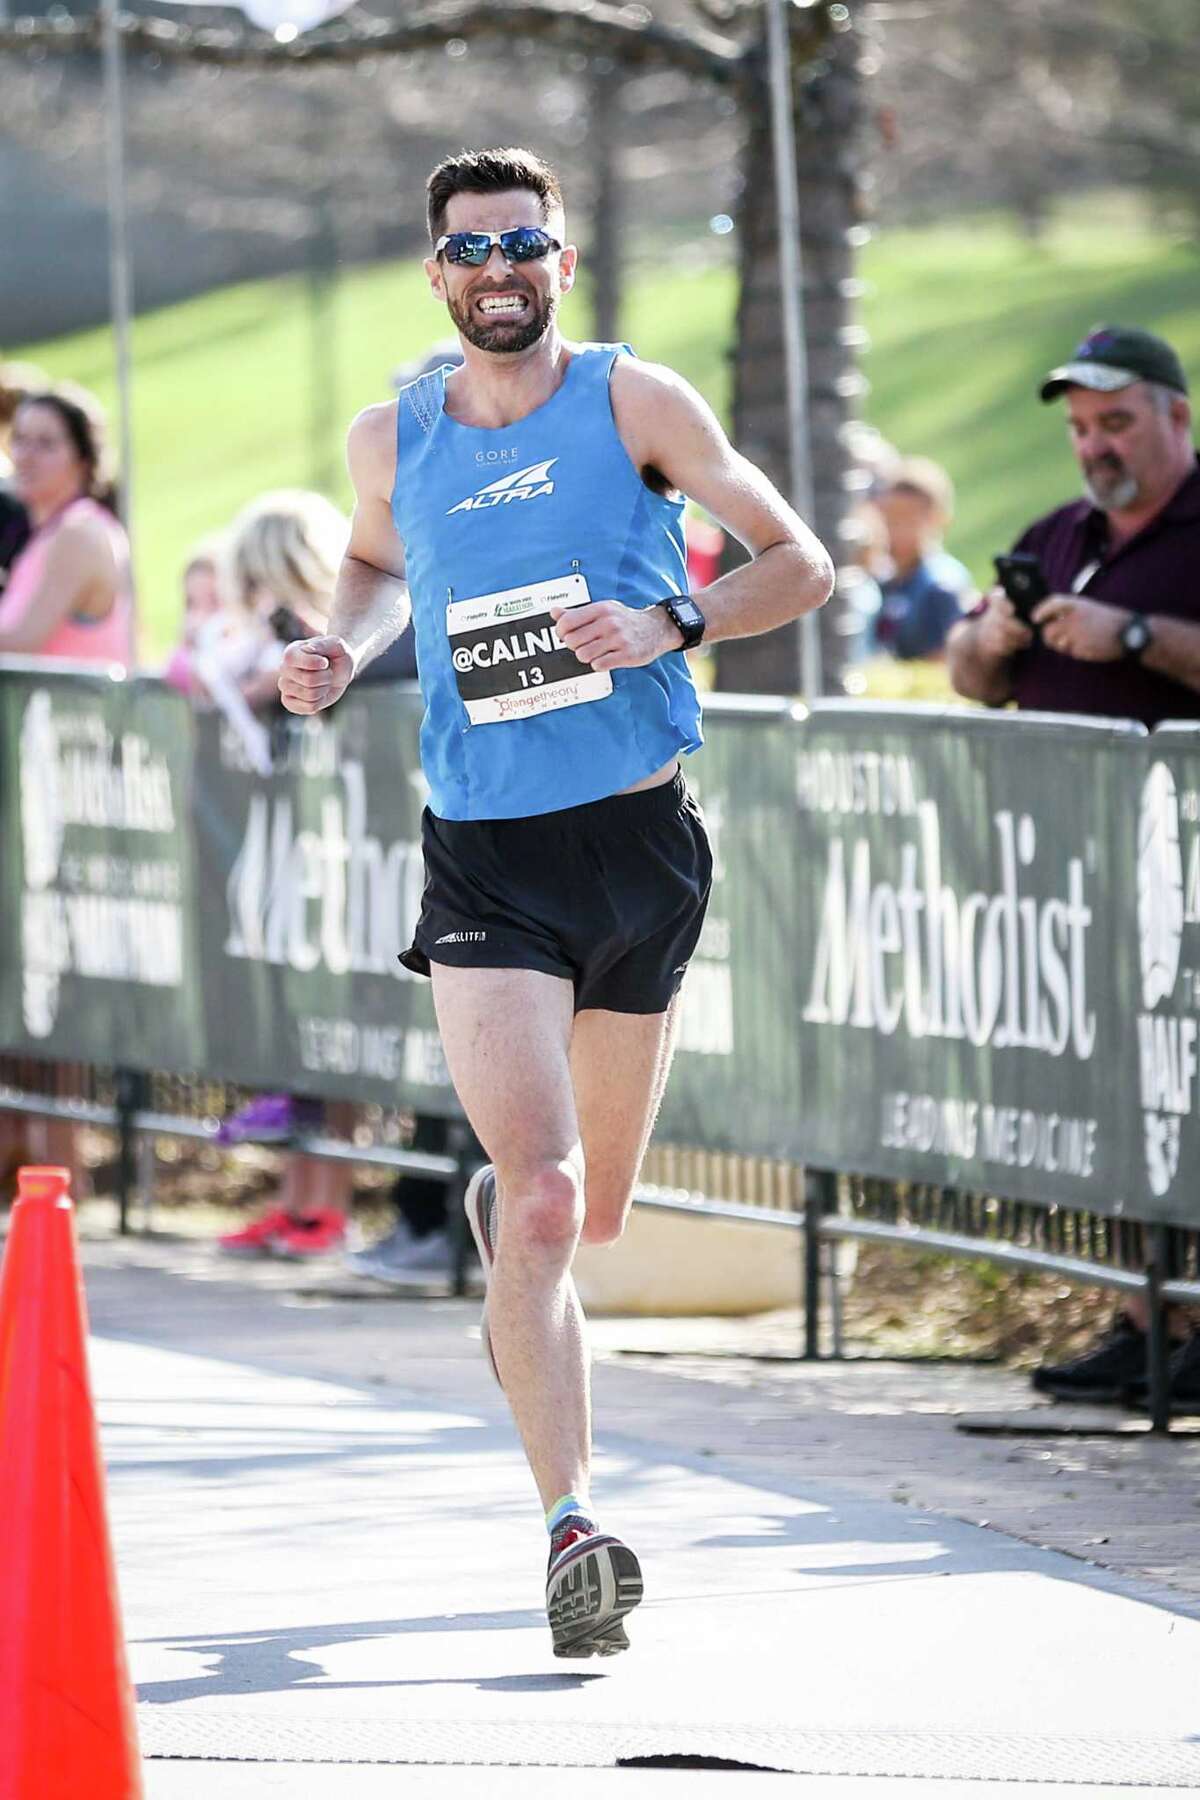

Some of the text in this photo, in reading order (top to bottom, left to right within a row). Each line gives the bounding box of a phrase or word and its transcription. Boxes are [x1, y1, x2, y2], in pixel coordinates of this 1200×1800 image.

[475, 447, 518, 463] GORE
[445, 481, 554, 516] ALTRA
[518, 667, 545, 687] 13
[801, 799, 1097, 1060] Methodist
